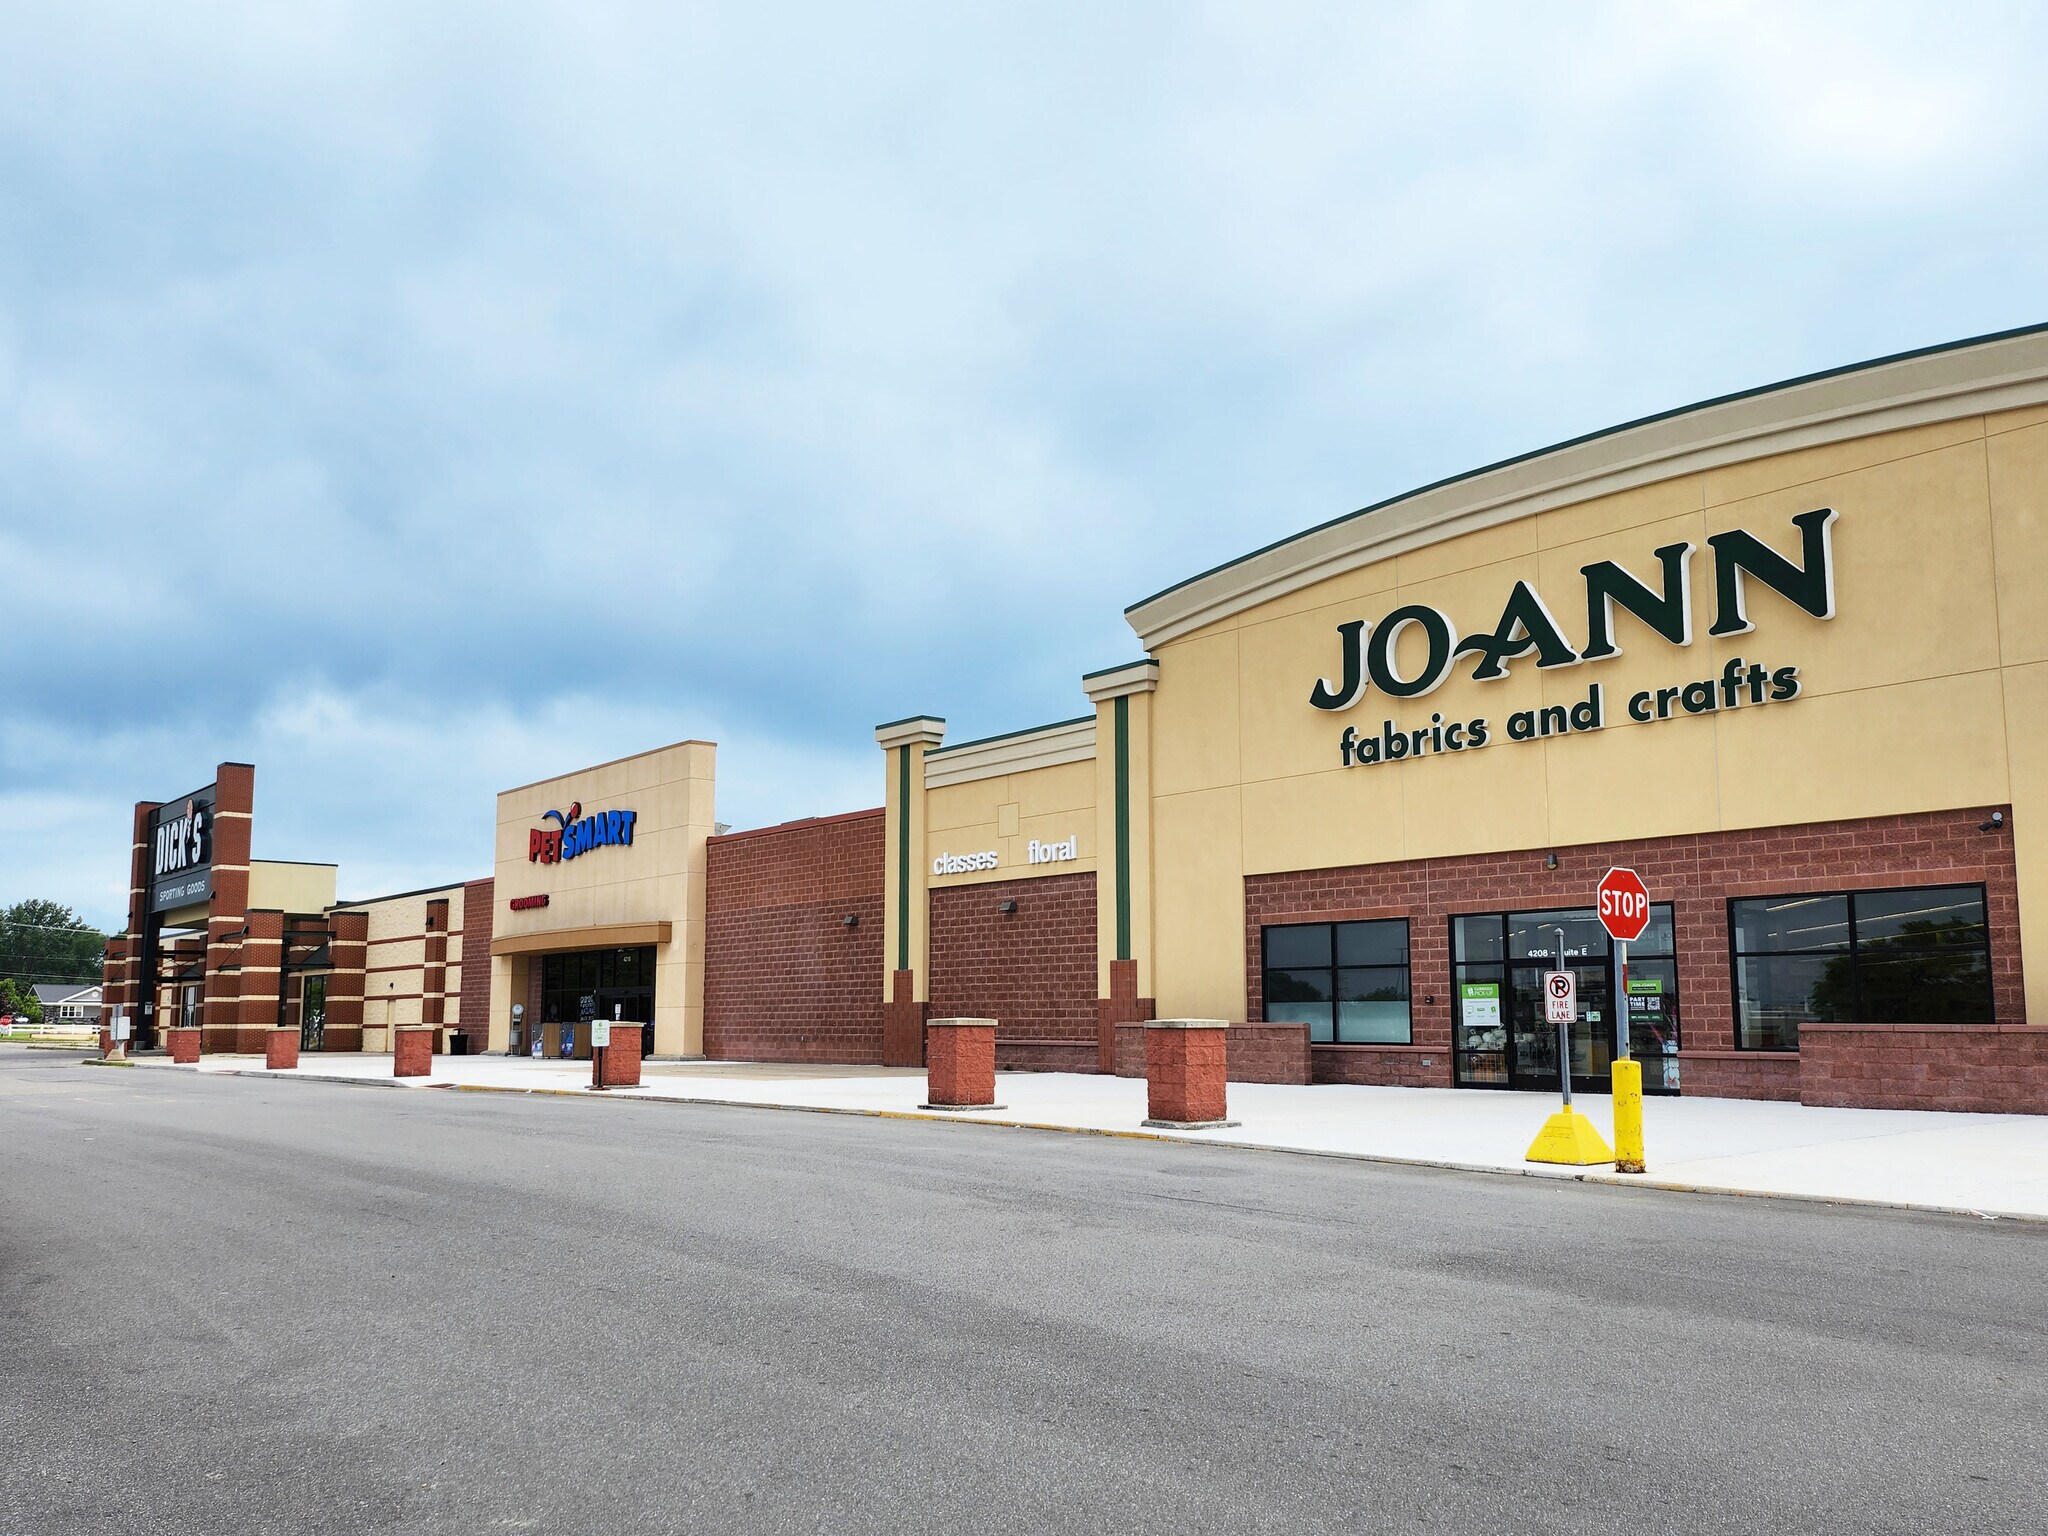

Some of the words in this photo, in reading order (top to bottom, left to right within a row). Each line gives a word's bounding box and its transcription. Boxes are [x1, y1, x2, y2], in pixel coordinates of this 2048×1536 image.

[1309, 507, 1839, 712] JOANN
[1340, 712, 1490, 768] fabrics
[1506, 682, 1605, 742] and
[1628, 656, 1802, 723] crafts
[155, 811, 203, 875] DICK'S
[933, 850, 999, 876] classes
[1027, 835, 1078, 865] floral
[159, 885, 185, 902] SPORTING
[186, 880, 205, 895] GOODS
[510, 893, 550, 912] GROOMING
[1602, 889, 1646, 918] STOP
[1527, 949, 1548, 957] 4208
[1563, 948, 1579, 956] uite
[1581, 947, 1588, 956] E
[1551, 1011, 1570, 1019] LANE
[1552, 1000, 1569, 1009] FIRE
